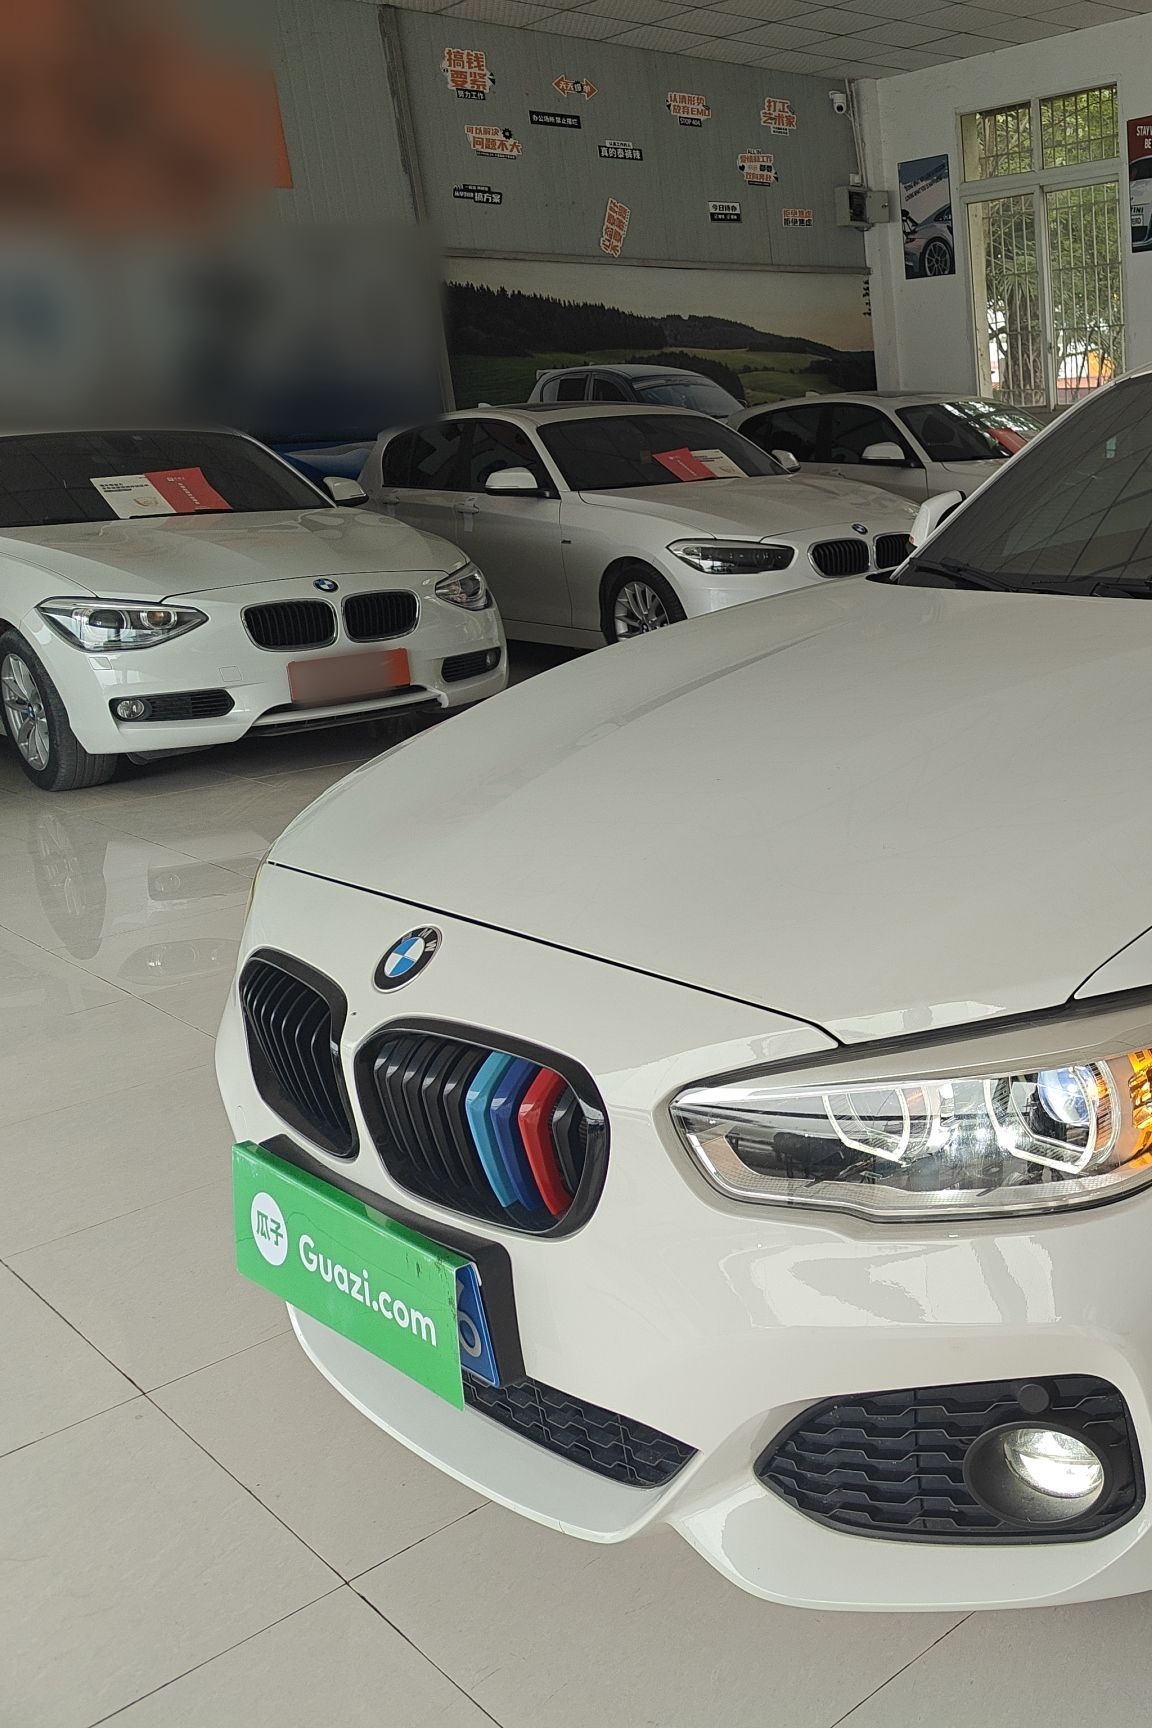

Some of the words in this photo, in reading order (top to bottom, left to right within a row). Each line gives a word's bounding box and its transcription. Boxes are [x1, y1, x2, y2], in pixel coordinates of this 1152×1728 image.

[446, 48, 485, 72] 搞钱
[450, 70, 488, 91] 要紧
[458, 90, 484, 99] 努力工作
[767, 98, 790, 114] 打工
[762, 111, 797, 128] 艺术家
[466, 126, 501, 136] 可以解决
[1136, 125, 1150, 137] STAY
[472, 136, 522, 153] 问题不大
[1144, 138, 1152, 149] BE
[256, 1209, 284, 1247] 瓜子
[298, 1233, 438, 1348] Guazi.com
